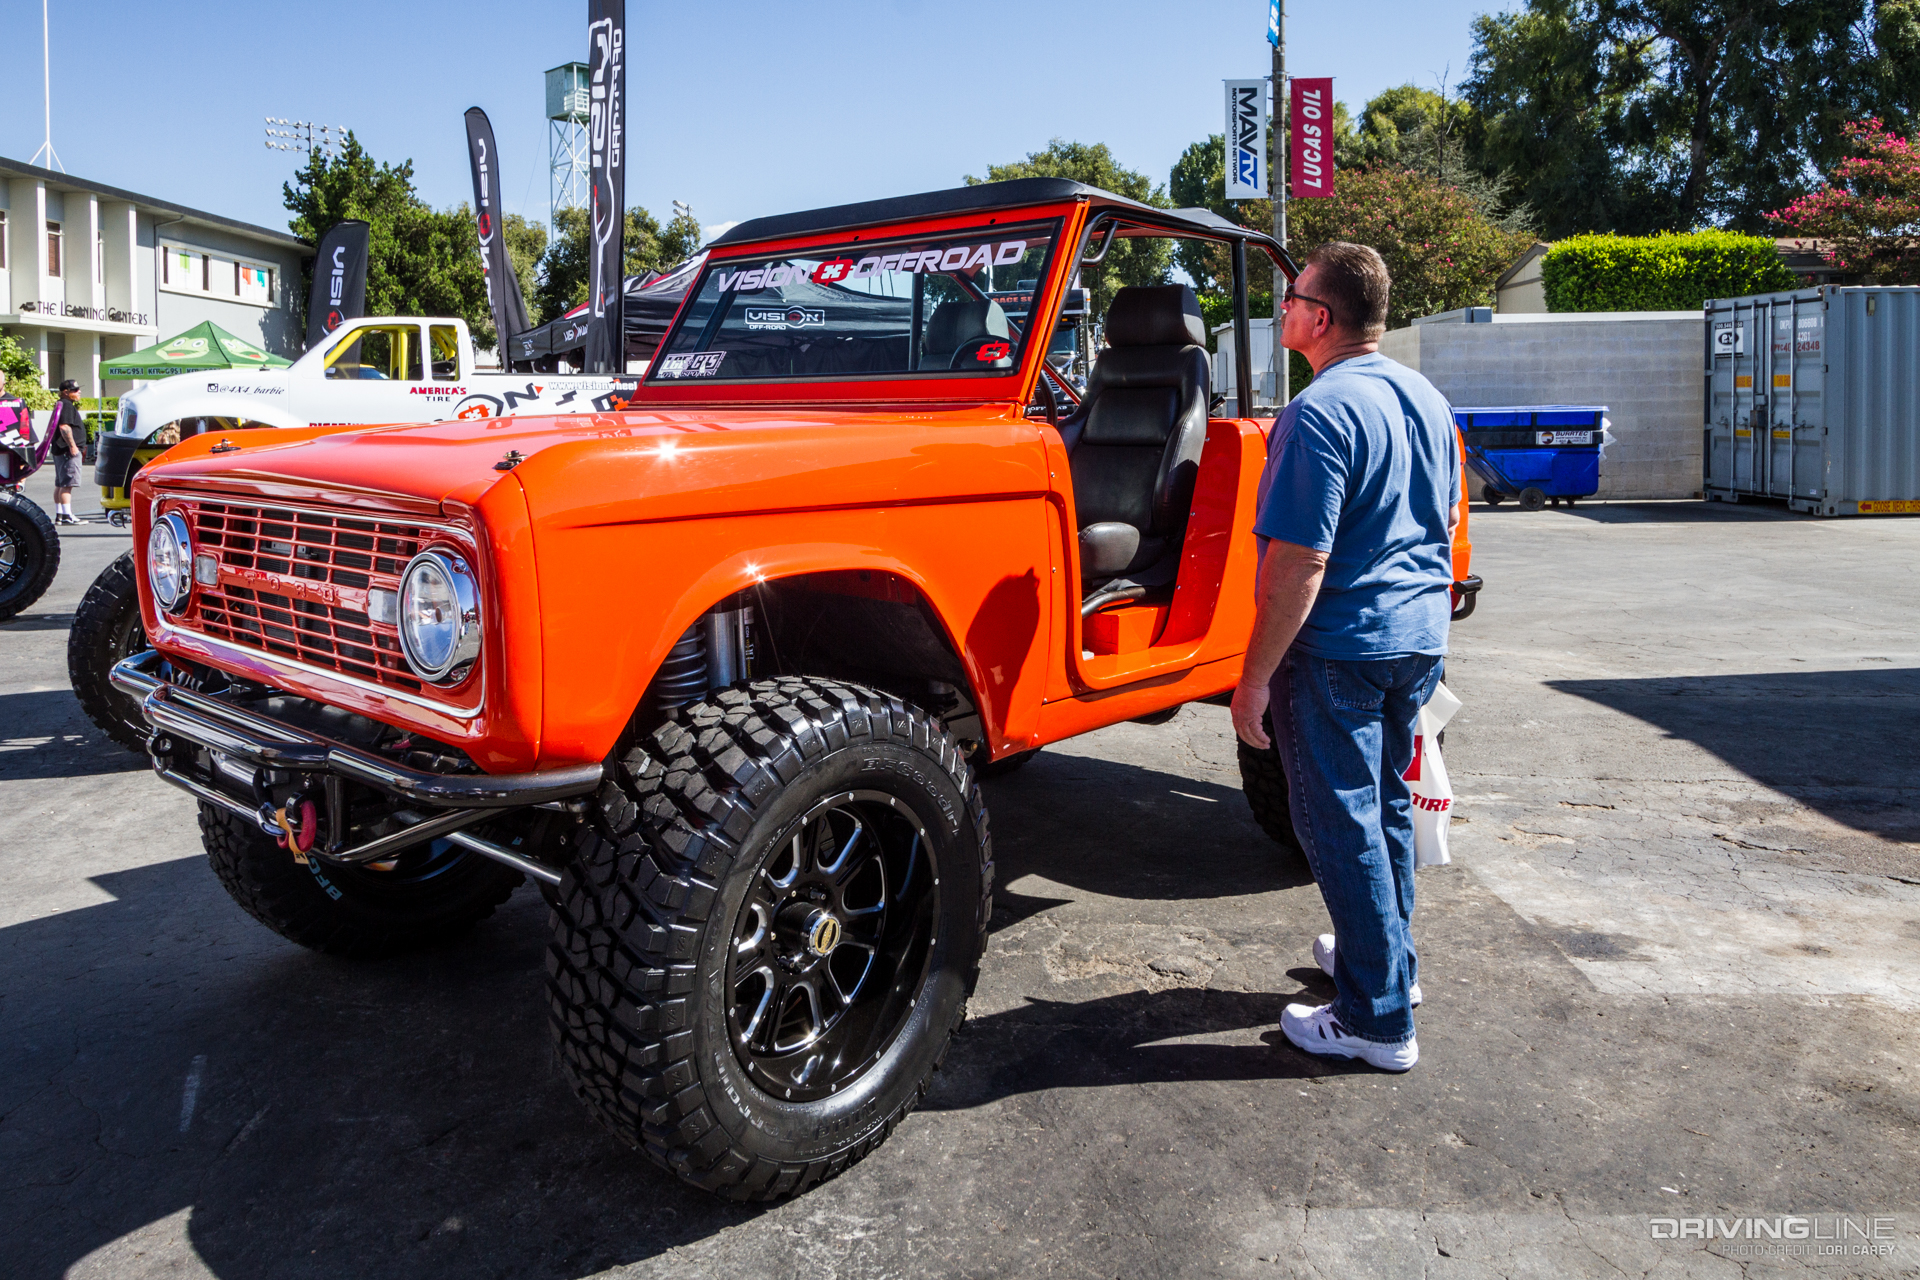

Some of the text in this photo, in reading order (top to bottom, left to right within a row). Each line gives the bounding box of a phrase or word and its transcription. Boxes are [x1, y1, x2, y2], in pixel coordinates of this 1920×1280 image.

[1238, 87, 1258, 189] MAVTV
[1302, 89, 1322, 189] LUCAS OIL
[718, 240, 1027, 293] VISION OFFROAD
[748, 309, 820, 325] VISION
[410, 386, 467, 395] AMERICA'S
[1411, 792, 1452, 812] TIRE
